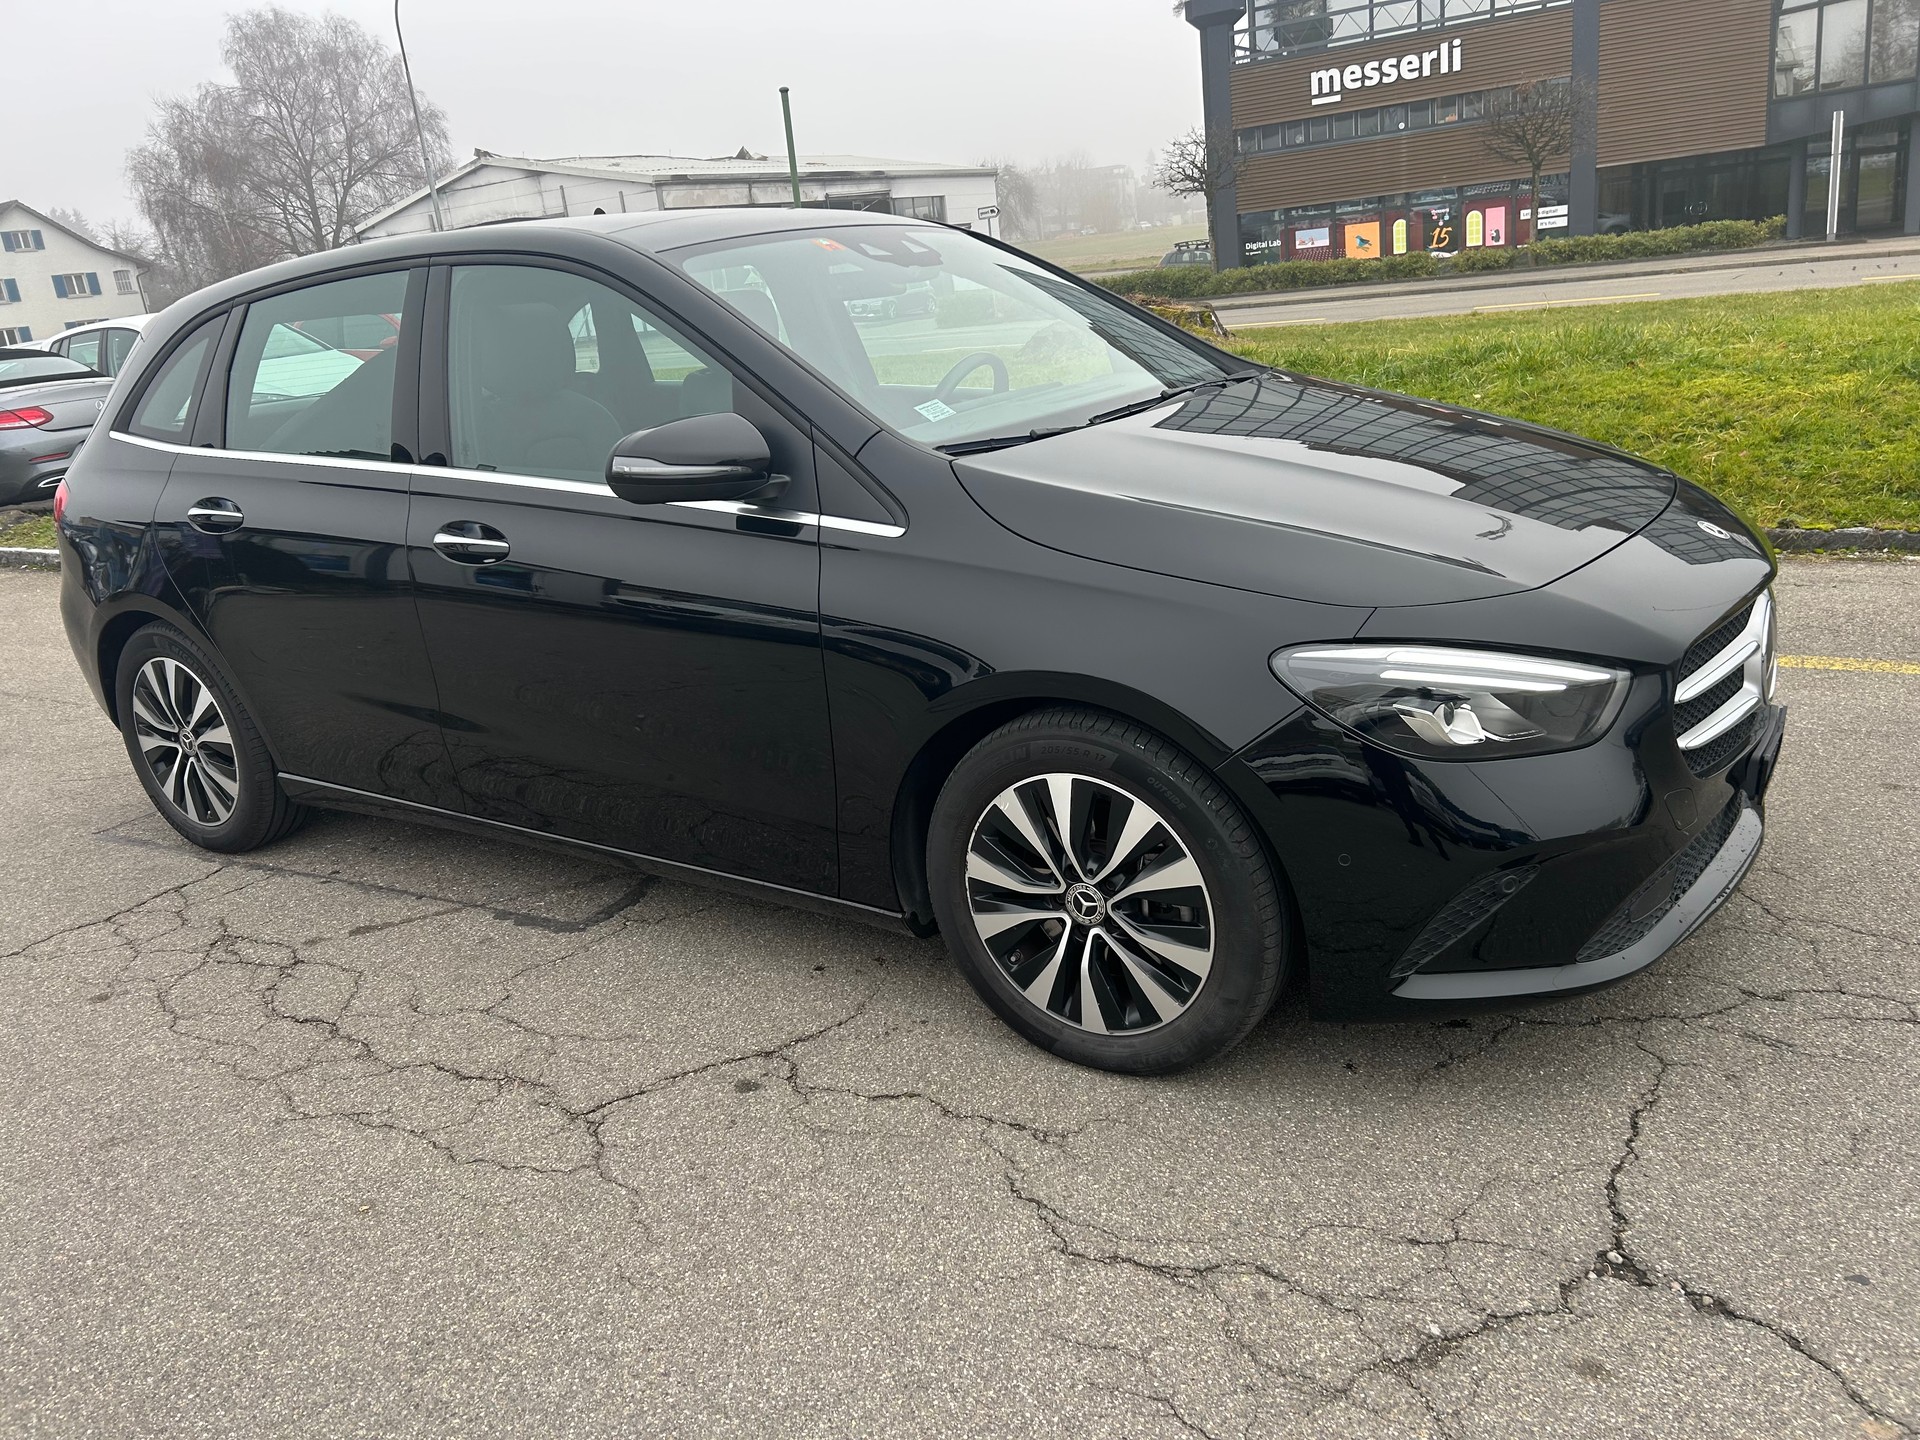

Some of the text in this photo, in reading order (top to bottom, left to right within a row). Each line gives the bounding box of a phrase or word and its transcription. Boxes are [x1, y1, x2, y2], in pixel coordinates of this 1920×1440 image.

[1311, 38, 1461, 98] messerli
[1245, 239, 1282, 251] Digital Lab
[1428, 227, 1453, 249] 15
[170, 645, 213, 687] MICHELIN
[1083, 749, 1091, 758] R
[1094, 752, 1107, 762] 17
[1146, 776, 1188, 810] OUTSIDE
